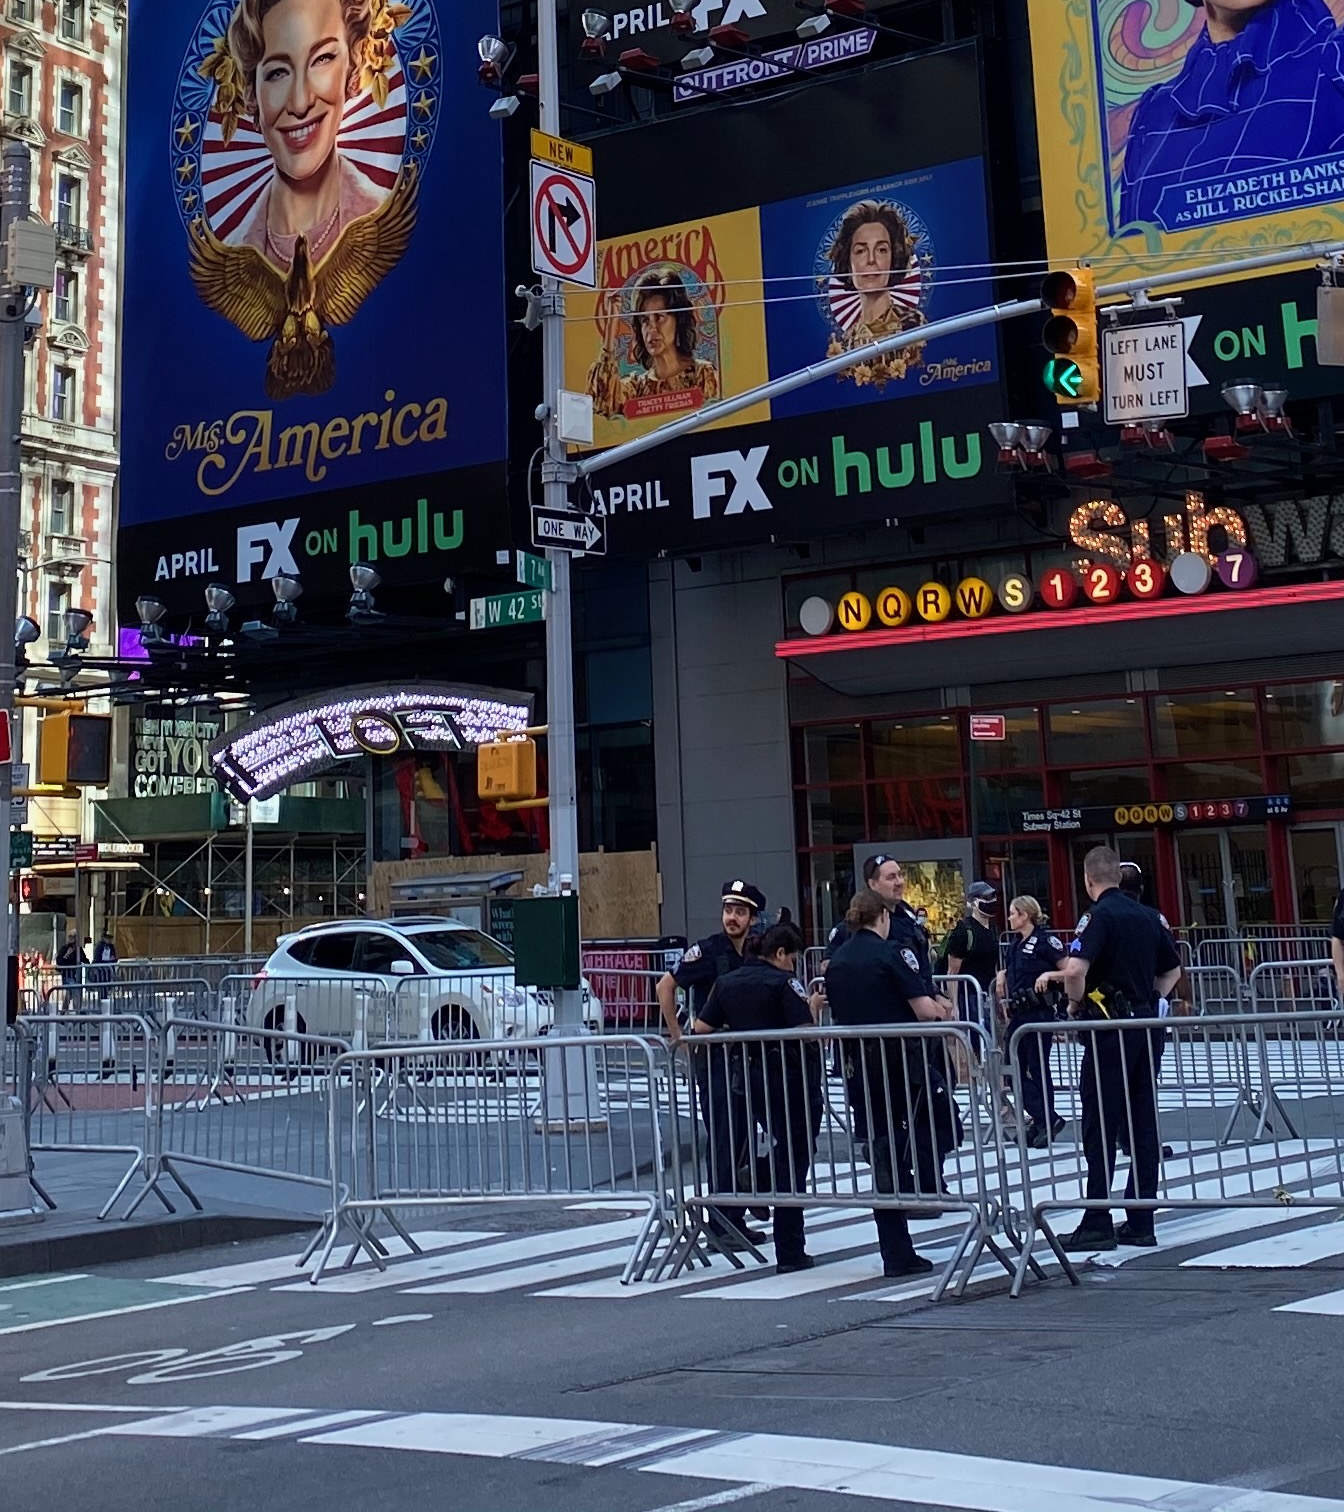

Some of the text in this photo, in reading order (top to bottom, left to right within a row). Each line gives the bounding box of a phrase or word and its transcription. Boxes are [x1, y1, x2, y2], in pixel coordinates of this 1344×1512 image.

[603, 5, 670, 42] PRIL
[806, 33, 870, 67] PRIME
[549, 140, 573, 163] NEW
[1185, 171, 1287, 204] ELIZABETH
[1175, 210, 1192, 222] AS
[1193, 197, 1229, 220] JILL
[1110, 334, 1178, 356] LEFT LANE
[1214, 325, 1266, 361] ON
[919, 358, 992, 386] America
[1123, 362, 1164, 382] MUST
[1112, 389, 1179, 410] TURN LEFT
[165, 389, 449, 496] Mrs. America
[589, 421, 982, 520] APRIL FX ON hulu
[154, 499, 464, 583] APRIL FX ON hulu
[543, 520, 594, 541] ONE WAY
[843, 554, 1243, 624] N Q R W S 1 2 3 7
[488, 593, 542, 623] W 42 St
[315, 708, 462, 760] LOFT
[135, 750, 167, 773] GOT
[1022, 811, 1045, 821] Times
[1072, 808, 1082, 818] St
[1023, 819, 1081, 832] Subway Station
